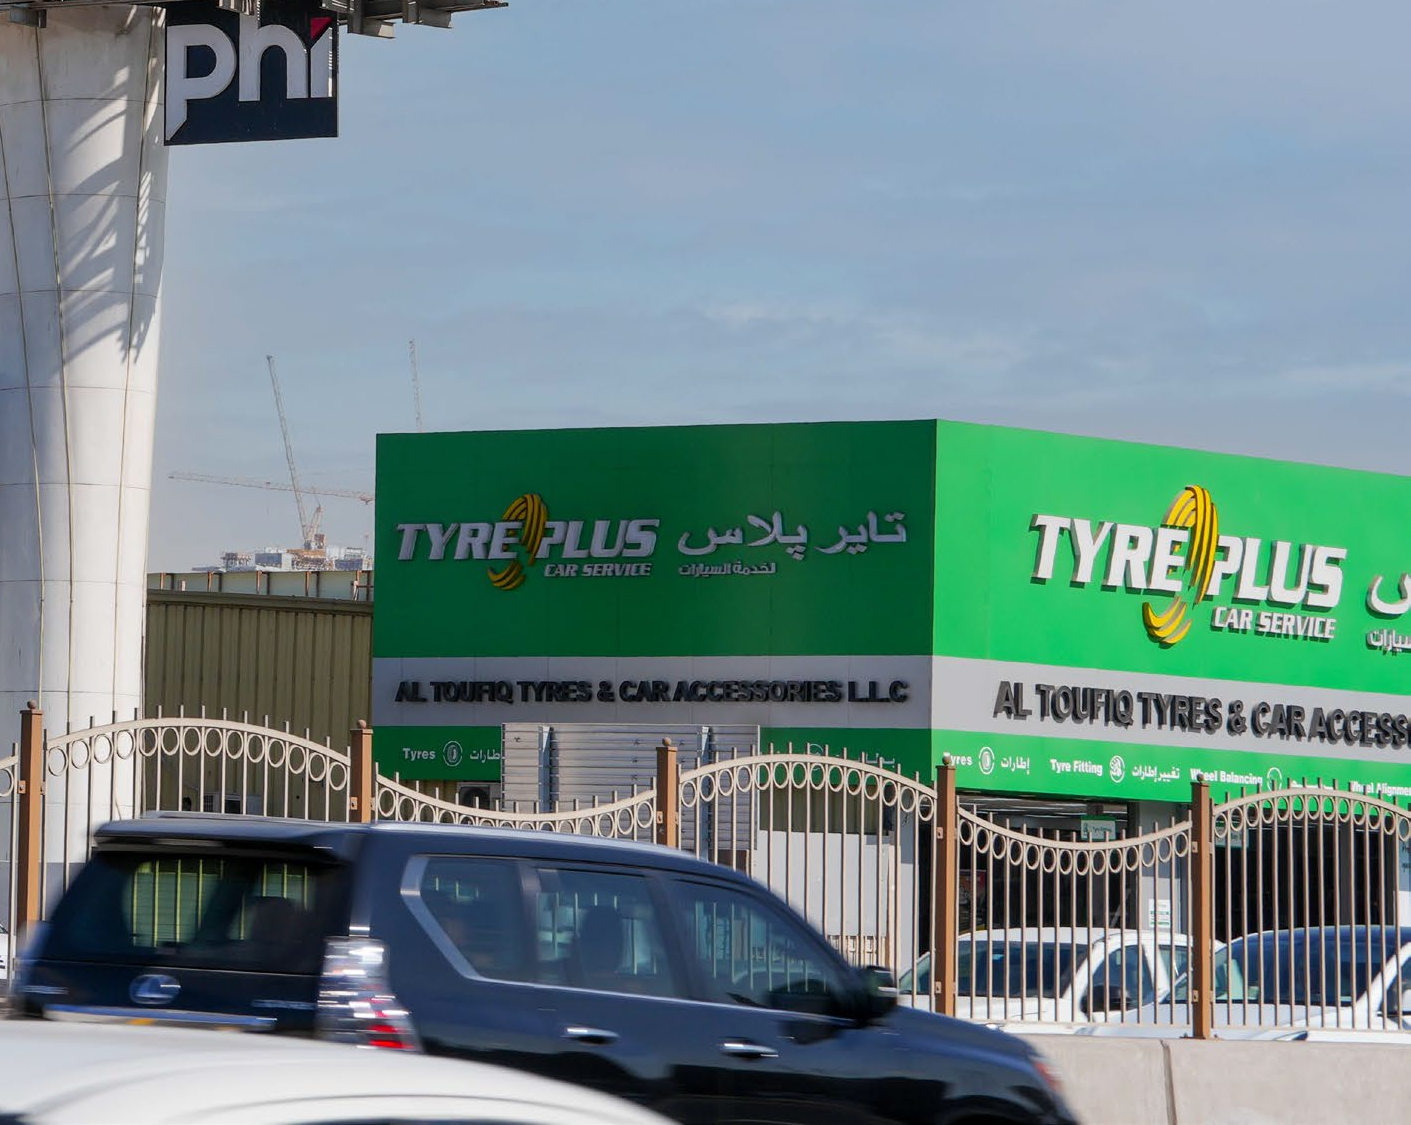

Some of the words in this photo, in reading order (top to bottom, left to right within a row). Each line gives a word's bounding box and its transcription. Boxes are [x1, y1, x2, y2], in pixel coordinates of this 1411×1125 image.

[397, 520, 523, 561] TYRE
[536, 518, 660, 560] PLUS
[814, 510, 907, 555] تاير
[544, 563, 578, 577] CAR
[581, 563, 652, 577] SERVICE
[1031, 513, 1190, 595] TYRE
[1206, 534, 1348, 610] PLUS
[1211, 606, 1254, 632] CAR
[1256, 610, 1337, 640] SERVICE
[394, 681, 427, 702] AL
[430, 681, 515, 704] TOUFIQ
[517, 681, 593, 702] TYRES
[596, 681, 615, 703] &
[619, 680, 672, 702] CAR
[673, 680, 842, 703] ACCESSORIES
[993, 681, 1032, 720] AL
[1035, 683, 1134, 726] TOUFIQ
[1137, 691, 1223, 734] TYRES
[1227, 699, 1248, 735] &
[1252, 701, 1307, 741] CAR
[402, 747, 436, 761] Tyres
[469, 748, 501, 764] طارات
[1001, 756, 1030, 775] إطارات
[1050, 758, 1071, 774] Tyre
[1073, 760, 1103, 777] Fitting
[1220, 770, 1263, 785] Balancing
